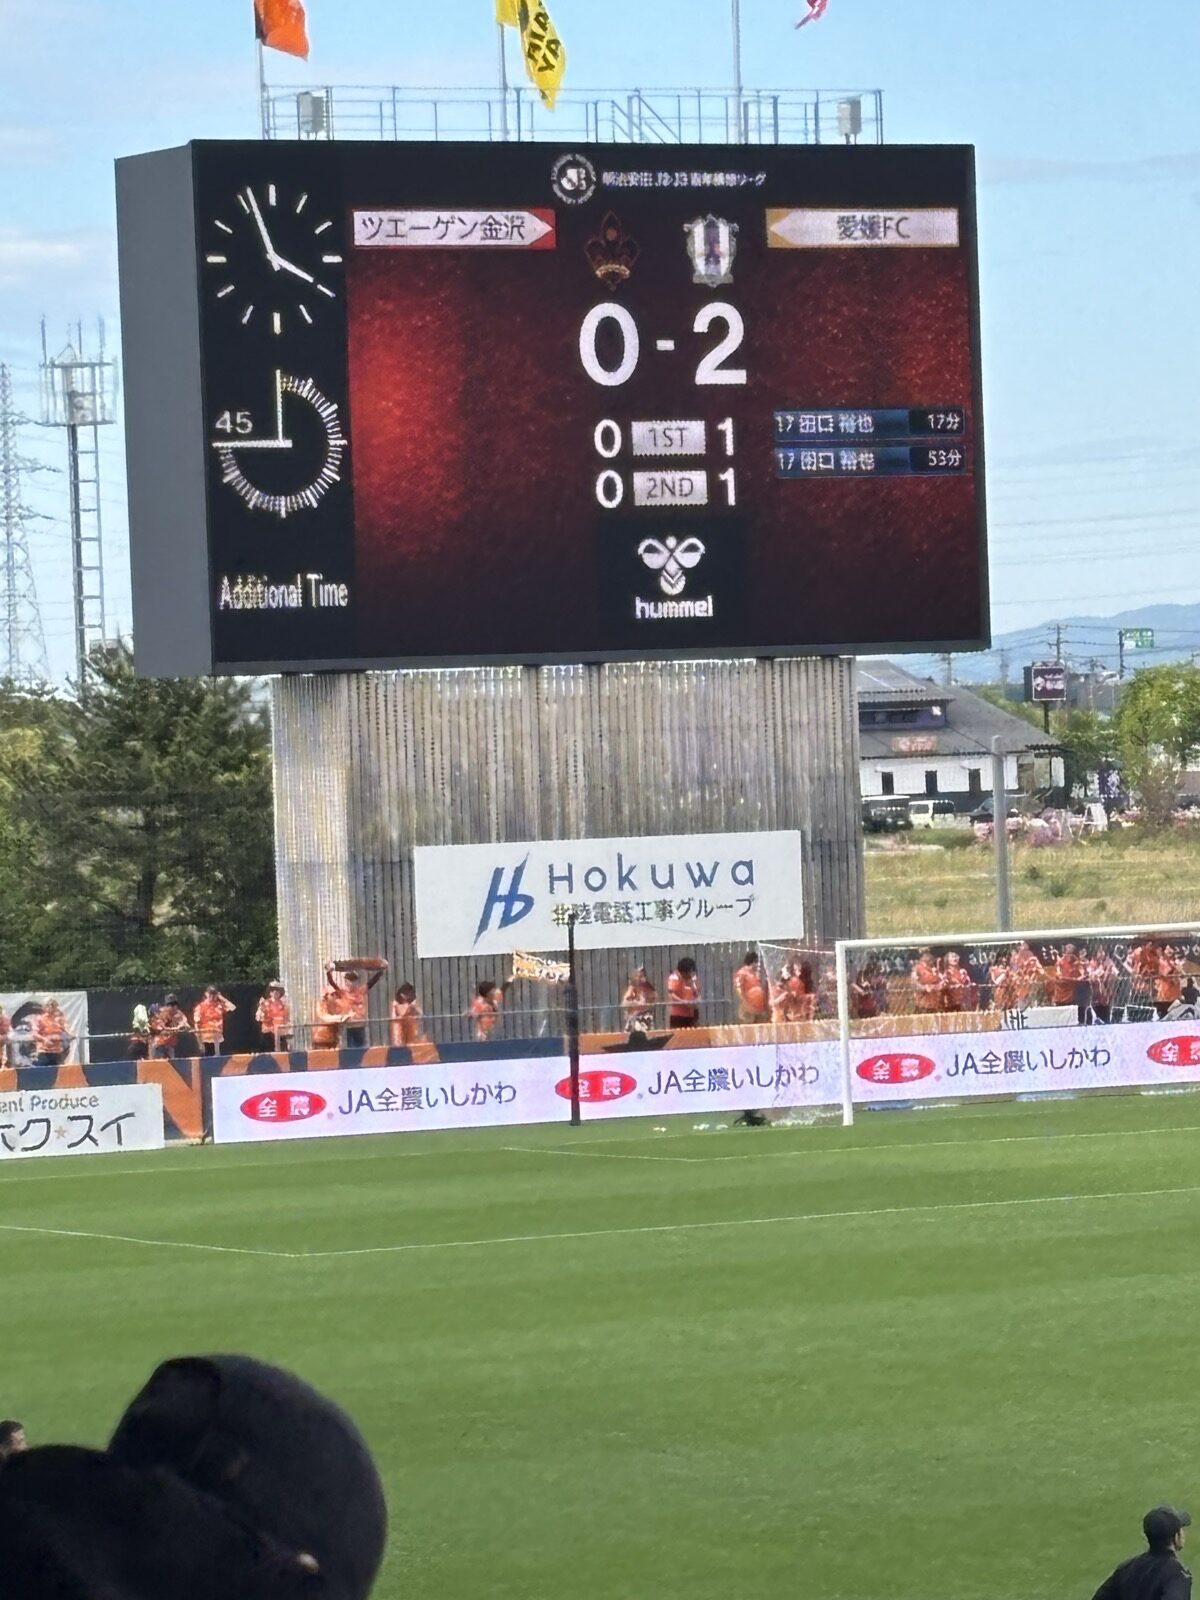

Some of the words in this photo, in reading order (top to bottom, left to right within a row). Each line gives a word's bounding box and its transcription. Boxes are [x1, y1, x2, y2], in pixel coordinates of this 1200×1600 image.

[361, 213, 527, 241] ツエーゲン金沢
[579, 302, 640, 387] 0
[693, 302, 748, 386] 2
[214, 410, 253, 434] 45
[594, 418, 622, 458] 0
[648, 426, 690, 448] 1ST
[716, 416, 734, 457] 1
[775, 414, 795, 433] 17
[927, 412, 961, 431] 17分
[776, 451, 796, 471] 17
[927, 448, 962, 467] 53分
[596, 469, 623, 509] 0
[645, 477, 695, 500] 2ND
[718, 467, 737, 507] 1
[218, 573, 303, 610] Additional
[306, 573, 349, 608] Time
[635, 595, 714, 619] hummel
[548, 852, 755, 895] Hokuwa
[945, 1046, 1111, 1078] JA全農いしかわ
[647, 1063, 820, 1096] JA全農いしかわ
[30, 1093, 100, 1112] Produce
[337, 1080, 518, 1116] JA全農いしかわ
